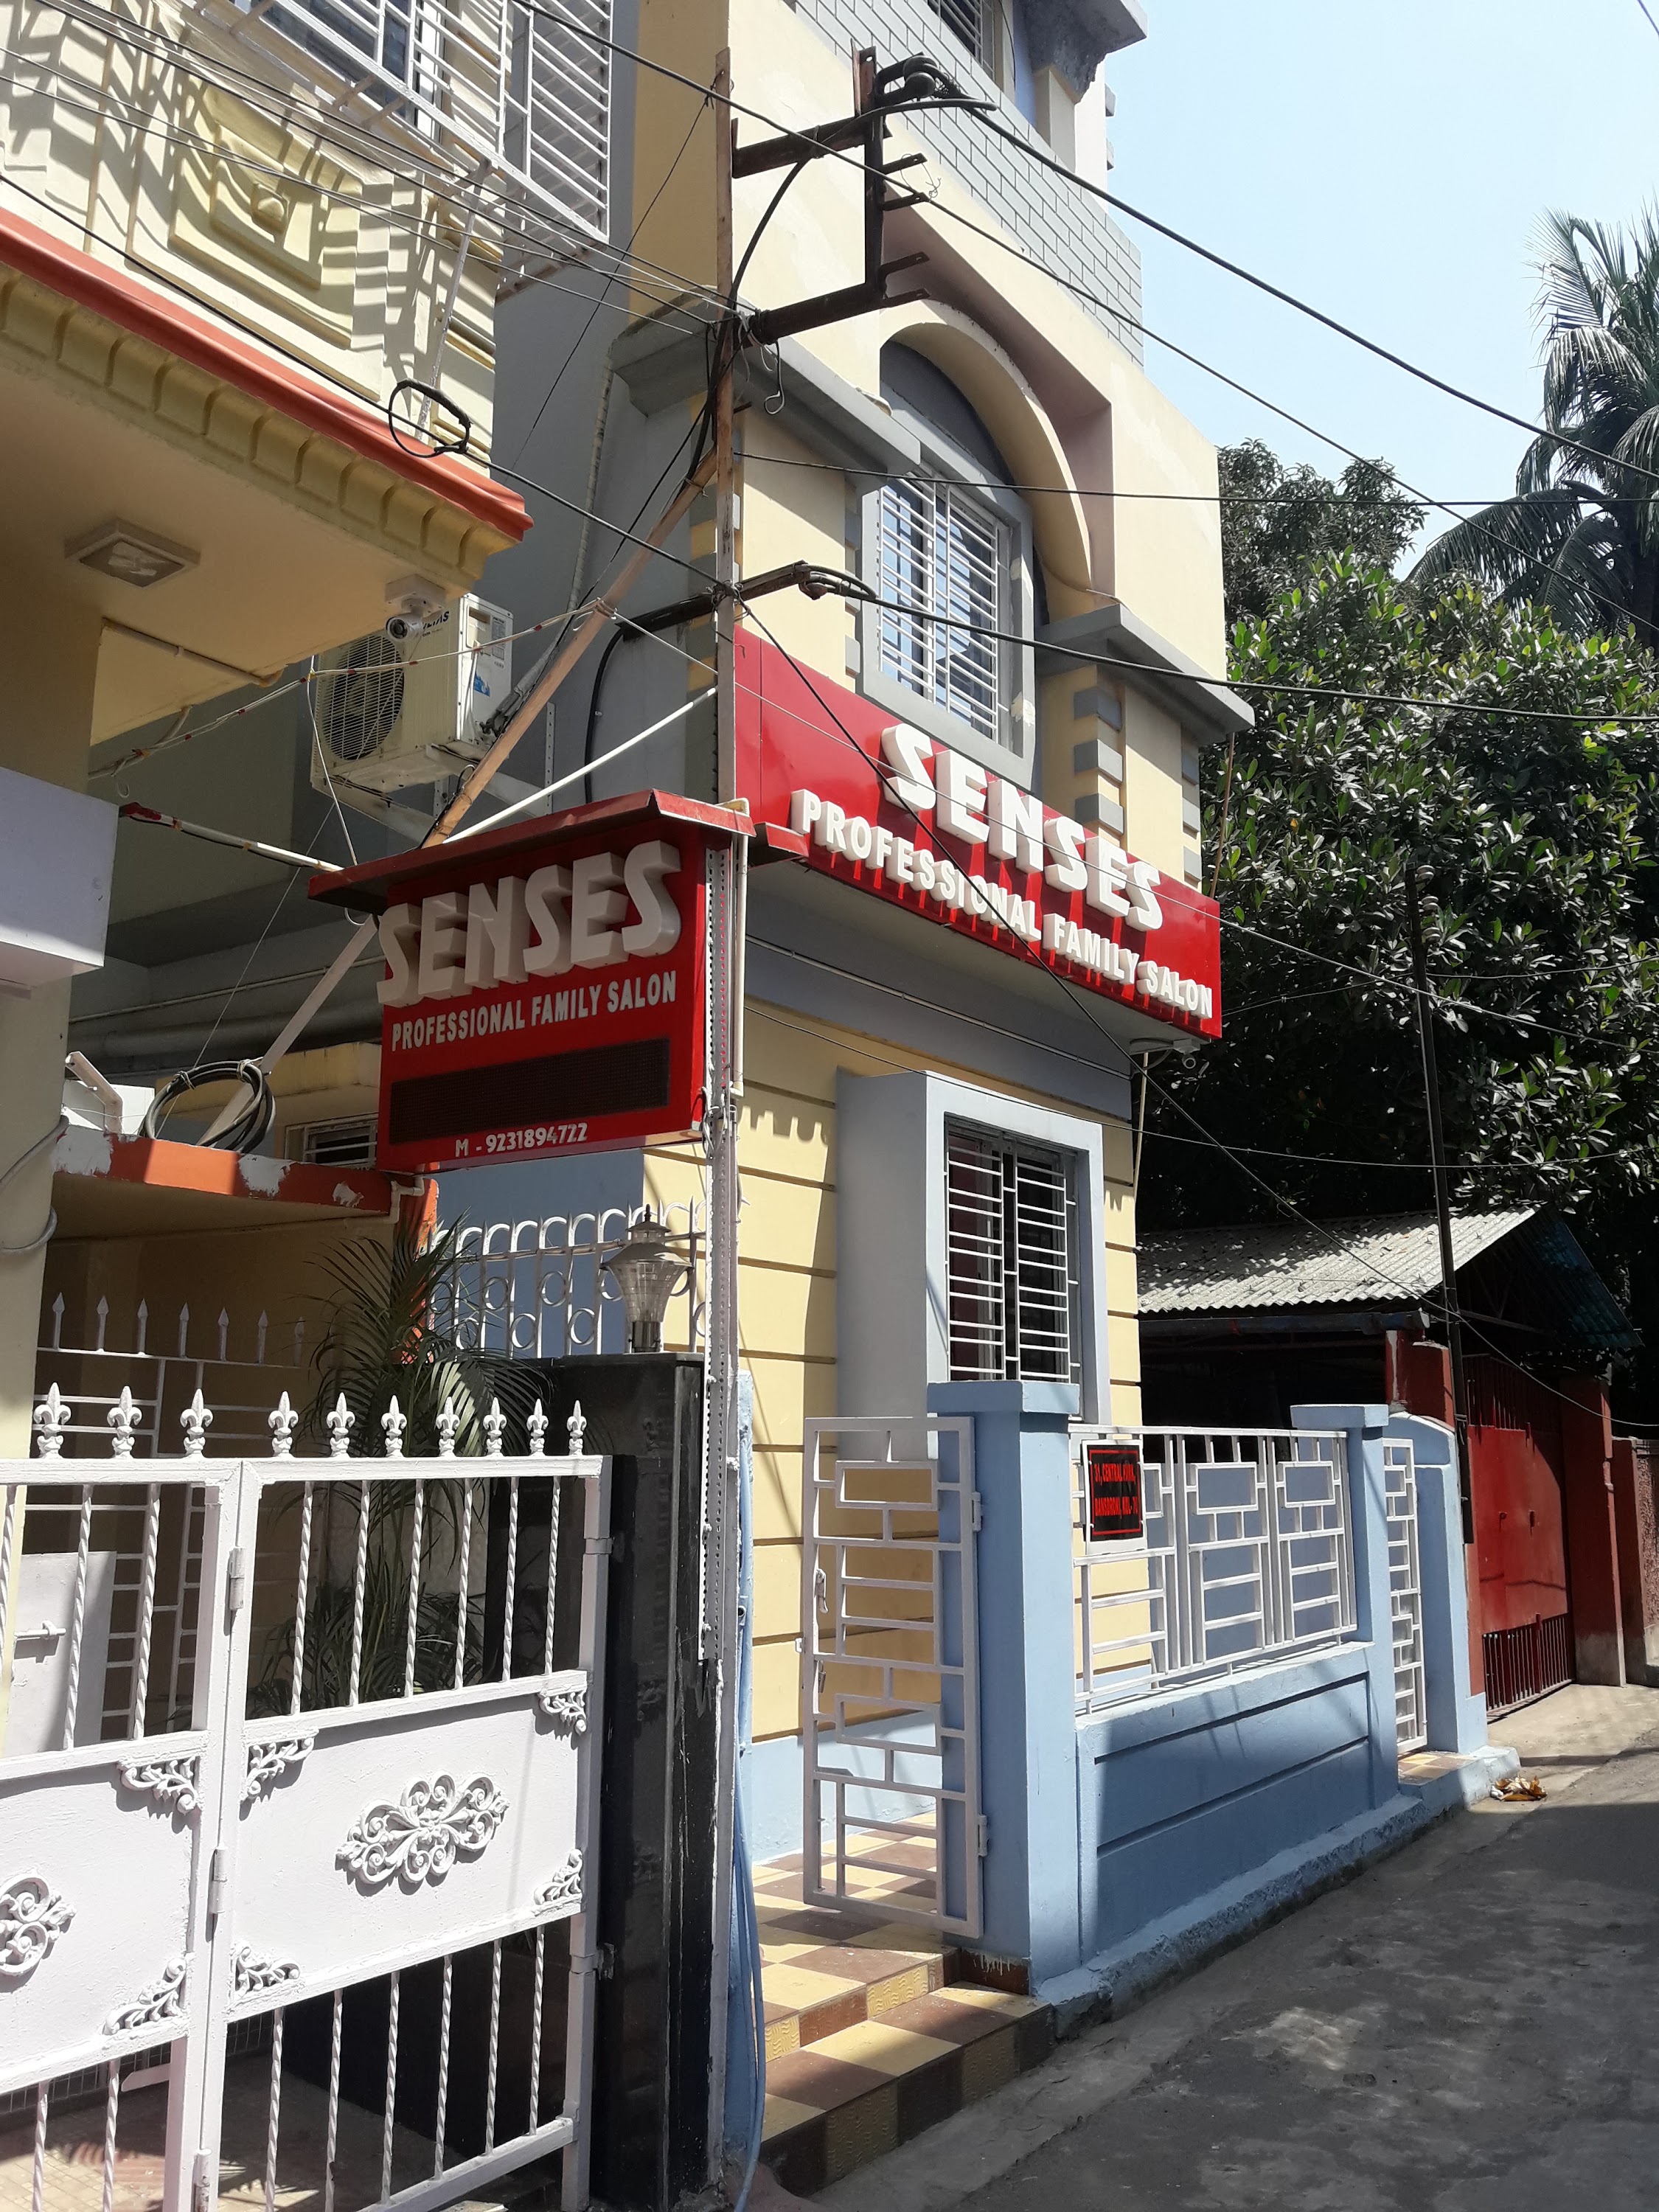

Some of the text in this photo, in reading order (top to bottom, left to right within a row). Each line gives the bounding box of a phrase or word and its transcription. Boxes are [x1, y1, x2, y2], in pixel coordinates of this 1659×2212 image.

[881, 723, 1164, 933] SENSES
[376, 839, 682, 1008] SENSES
[791, 788, 1214, 1020] PROFESSIONAL FAMILY SALON
[391, 970, 677, 1052] PROFESSIONAL FAMILY SALON
[455, 1138, 469, 1158] M
[485, 1122, 588, 1153] 9231894722
[1102, 1463, 1123, 1483] CENTRAL
